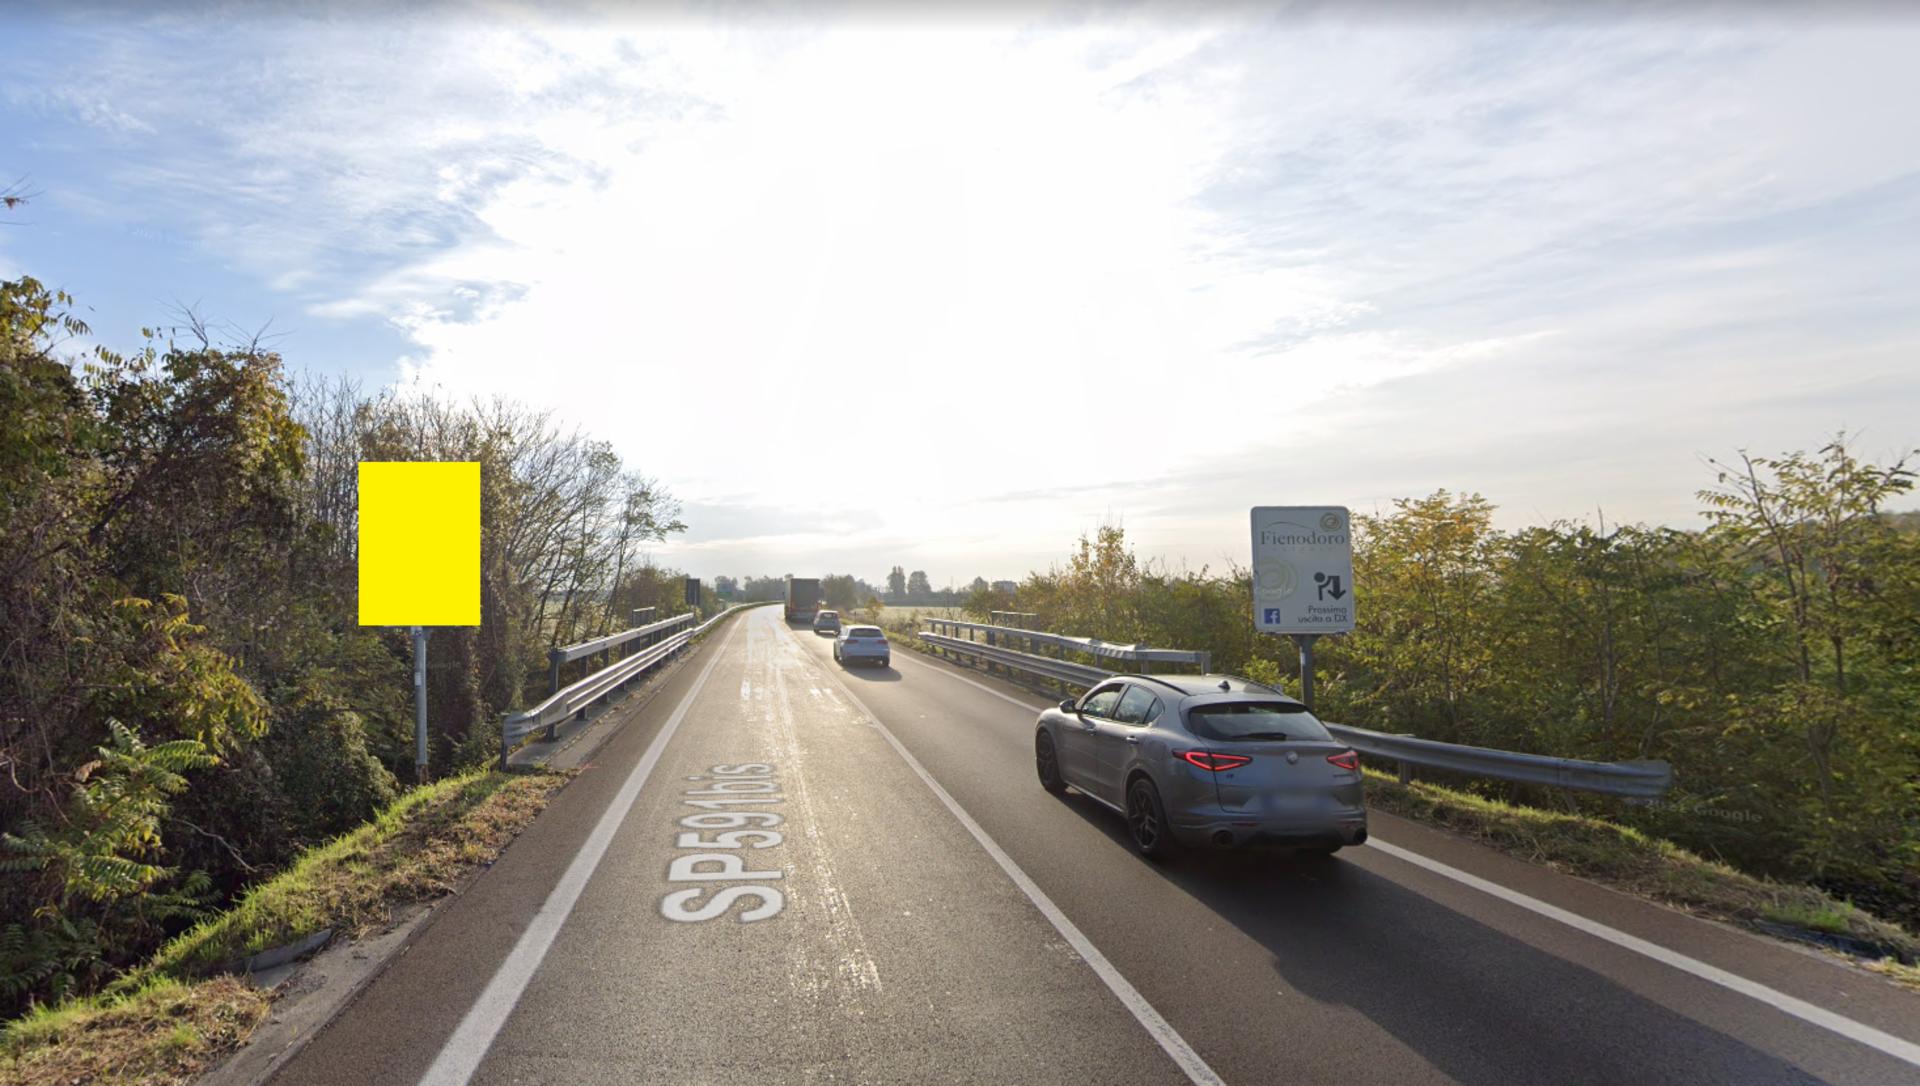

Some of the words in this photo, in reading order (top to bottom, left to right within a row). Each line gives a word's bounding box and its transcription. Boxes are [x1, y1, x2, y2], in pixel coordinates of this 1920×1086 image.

[1260, 530, 1345, 545] Fienodoro
[1308, 605, 1348, 614] Prossima
[1335, 614, 1348, 623] DX
